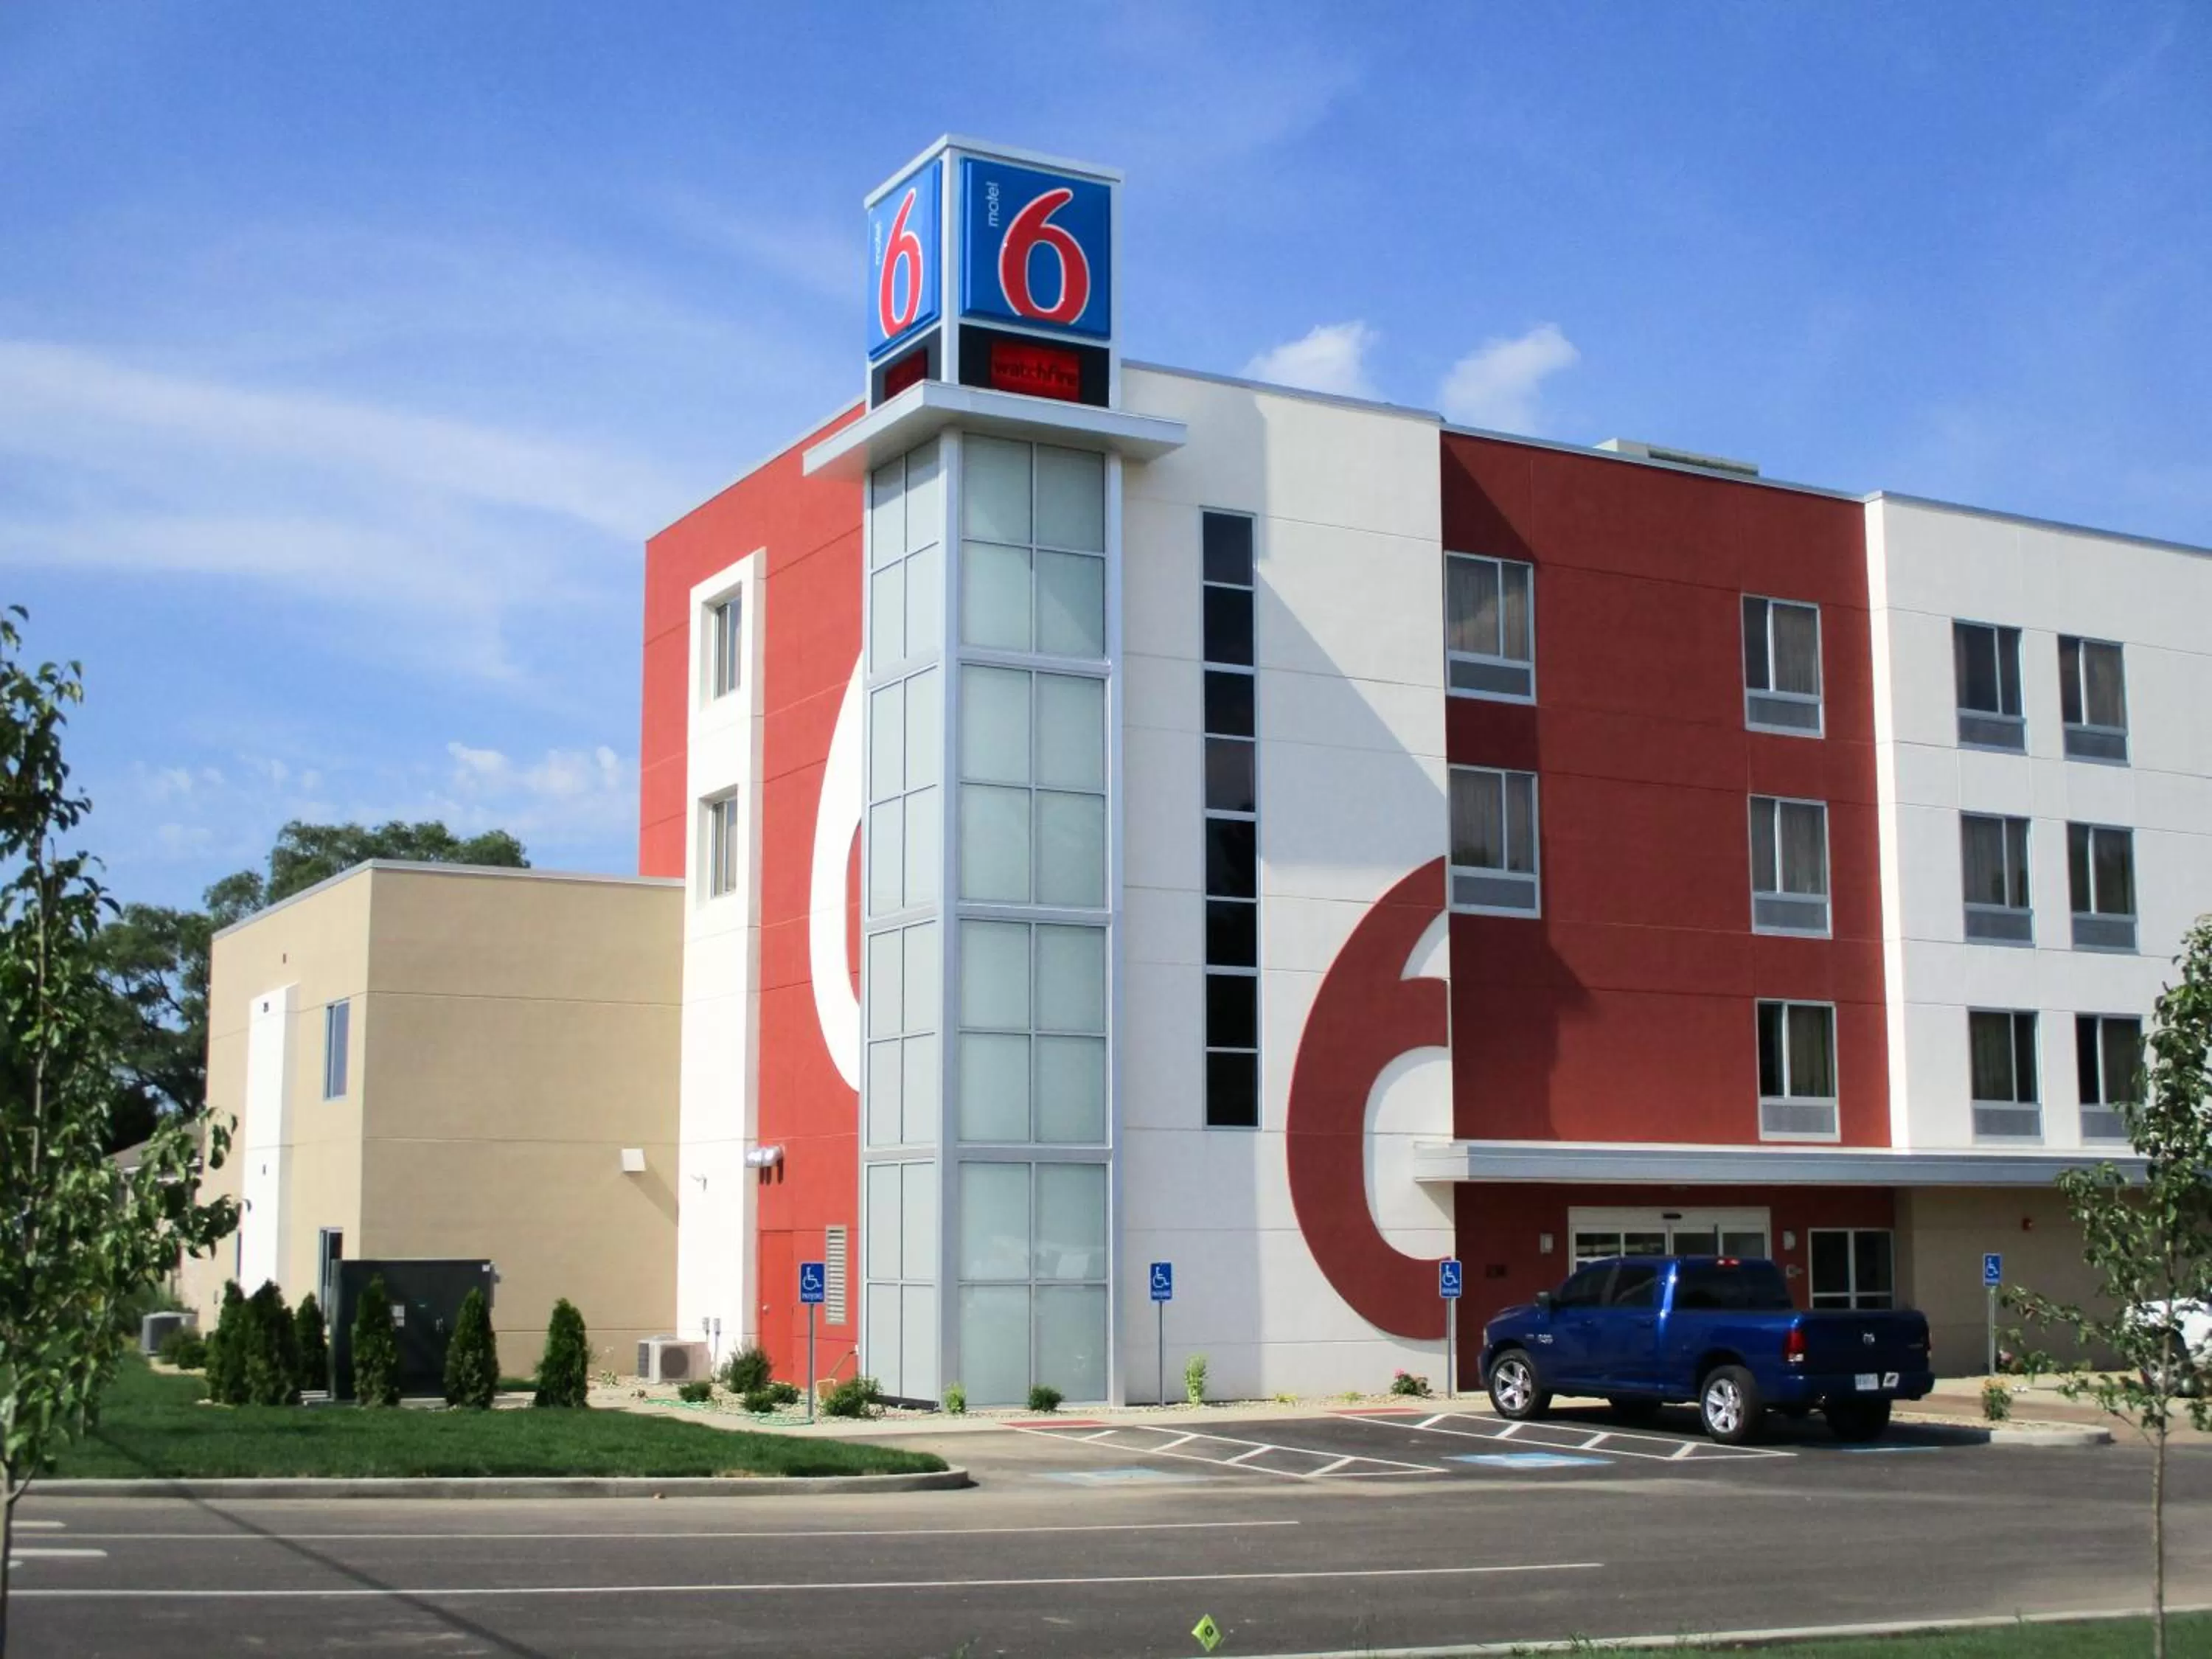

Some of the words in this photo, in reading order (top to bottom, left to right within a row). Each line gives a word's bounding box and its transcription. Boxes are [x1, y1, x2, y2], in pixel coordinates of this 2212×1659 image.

[879, 187, 923, 339] 6
[985, 181, 999, 227] motel
[998, 187, 1090, 324] 6
